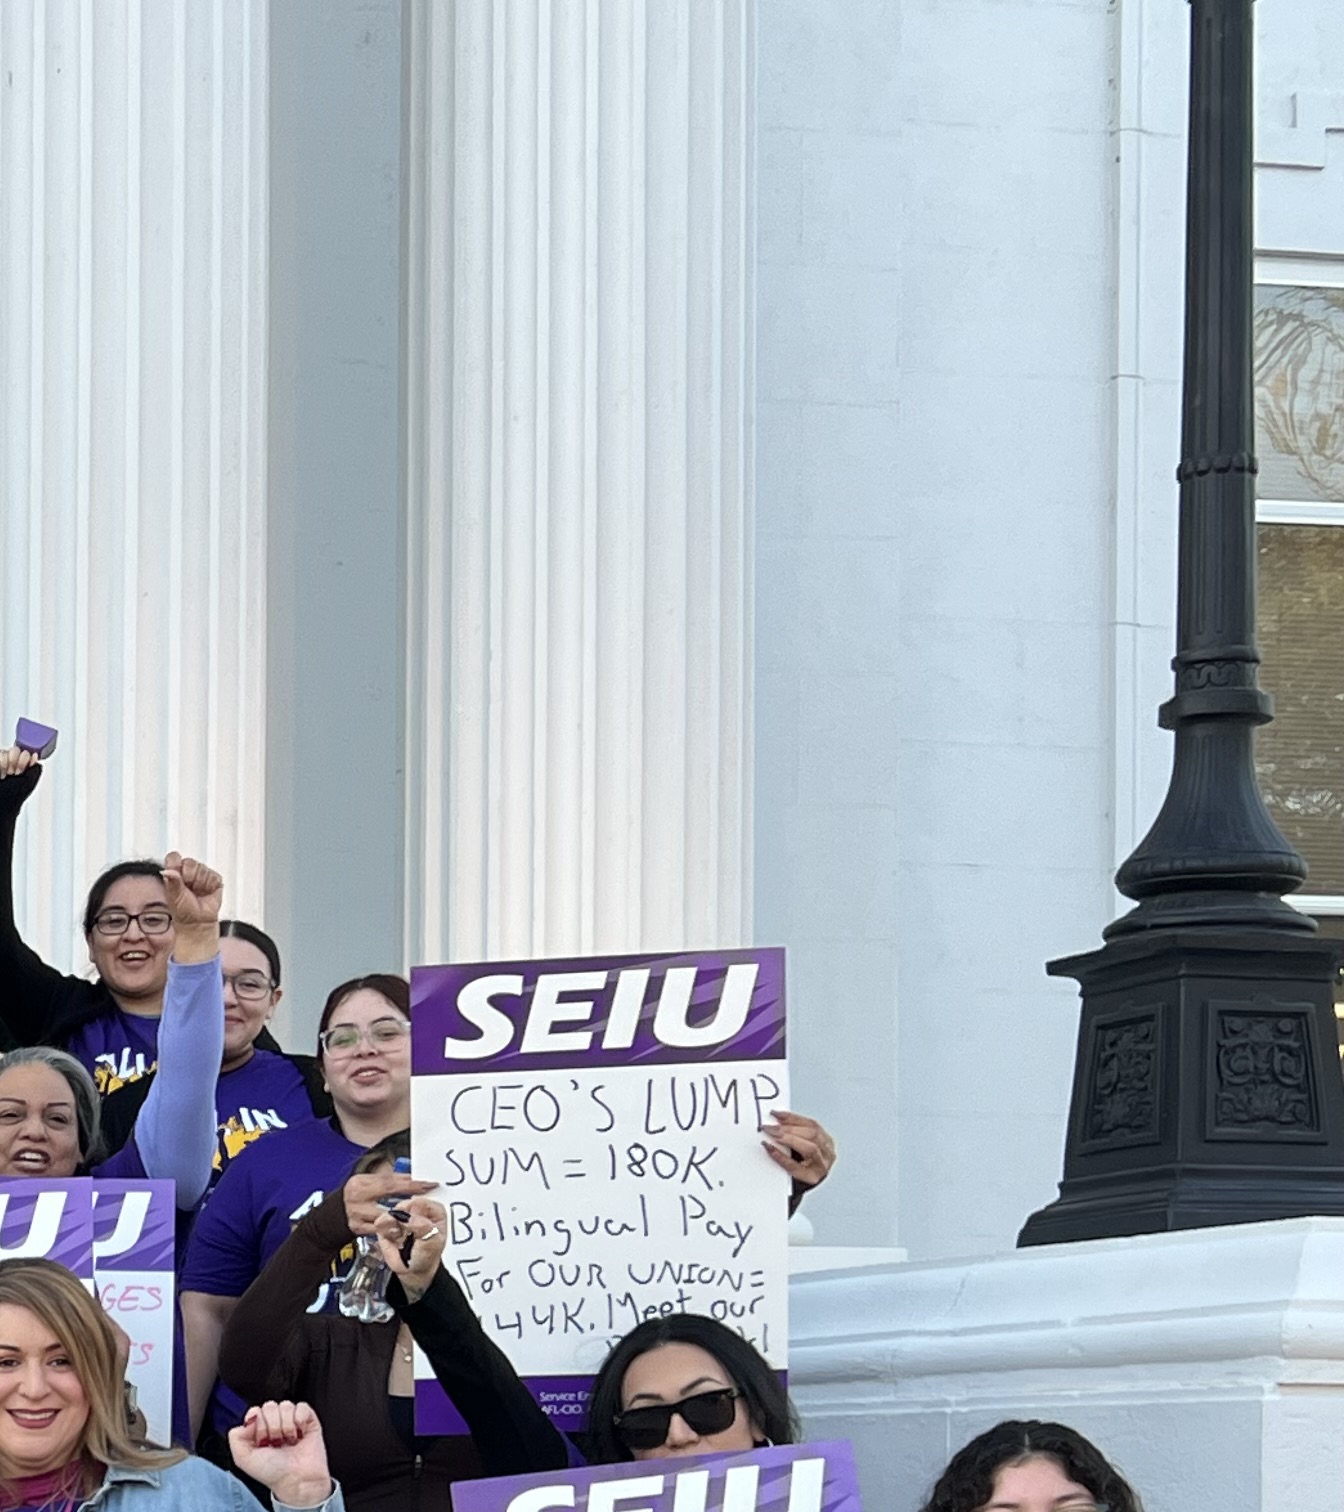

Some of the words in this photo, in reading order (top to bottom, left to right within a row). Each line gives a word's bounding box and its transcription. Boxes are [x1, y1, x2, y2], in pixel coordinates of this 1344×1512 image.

[444, 963, 759, 1059] SEIU
[450, 1080, 613, 1134] CEO'S
[644, 1073, 779, 1135] LUMP
[445, 1146, 550, 1189] SUM
[449, 1195, 649, 1256] Bilingual
[681, 1194, 753, 1258] Pay
[528, 1259, 607, 1290] OUR
[711, 1296, 764, 1320] our
